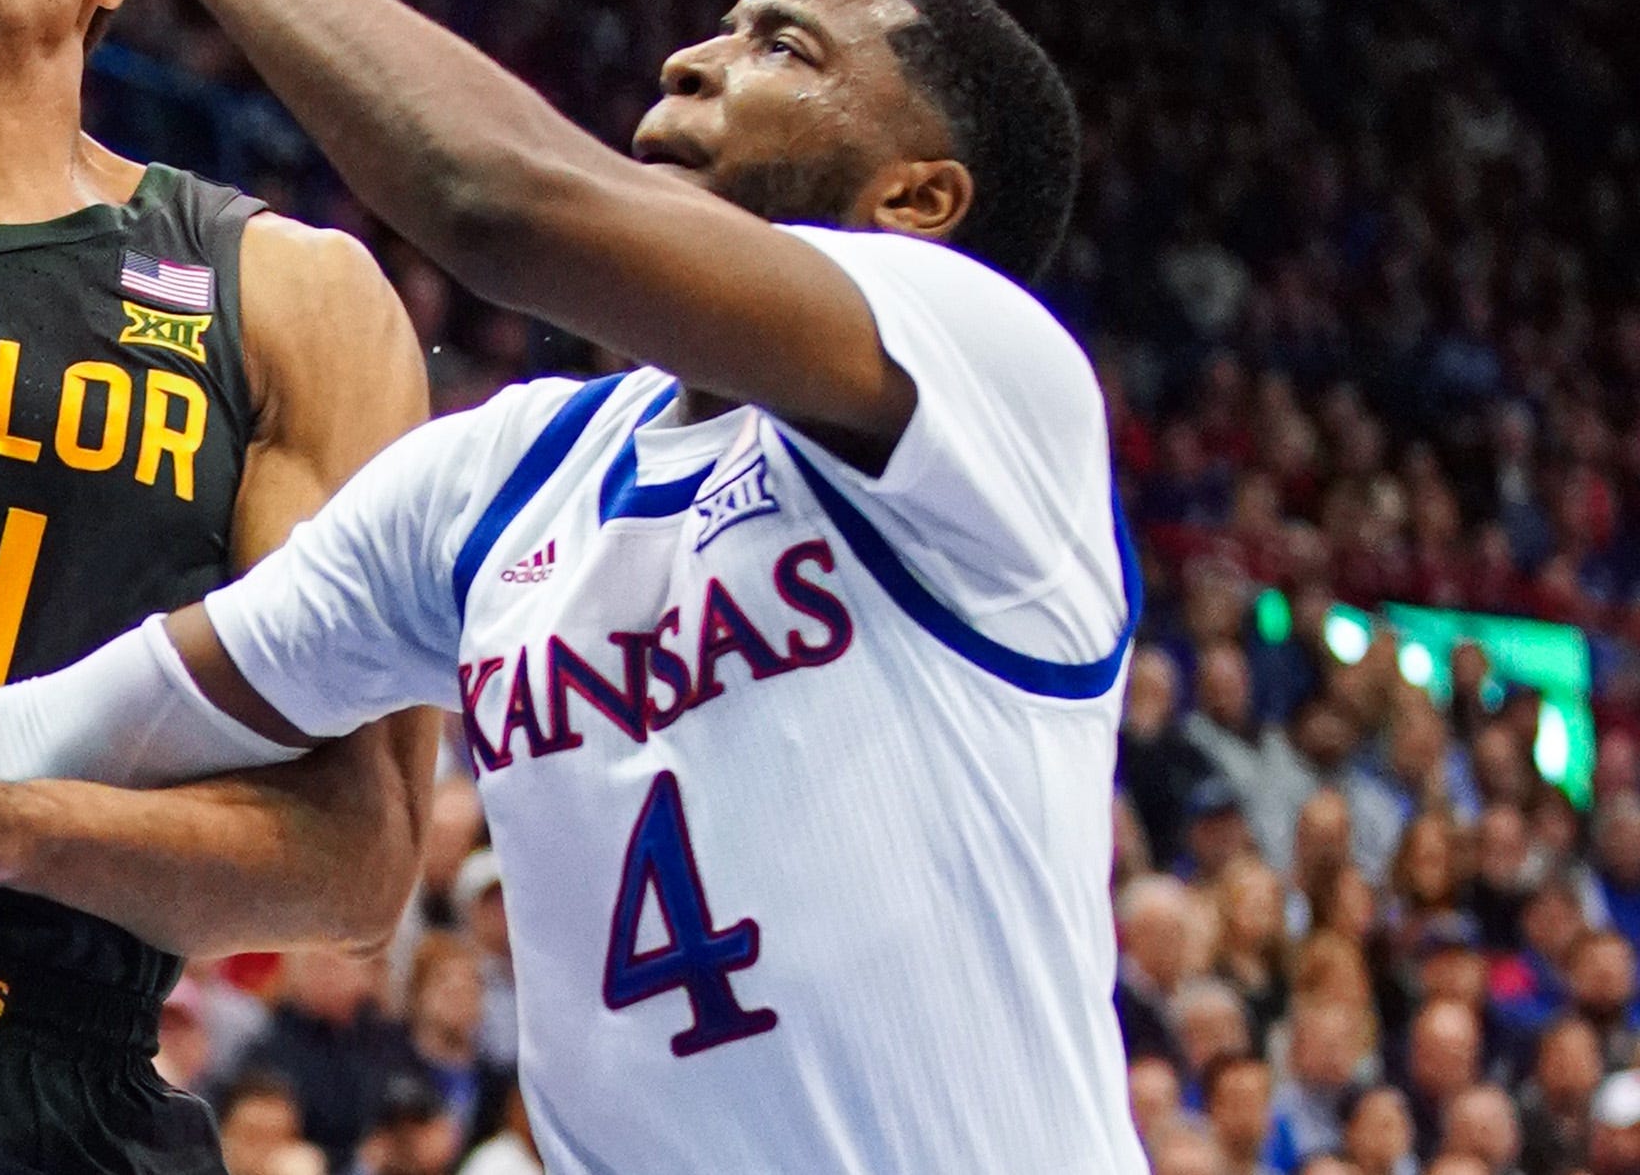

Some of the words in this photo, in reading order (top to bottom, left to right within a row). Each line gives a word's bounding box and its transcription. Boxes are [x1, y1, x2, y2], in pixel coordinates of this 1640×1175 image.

[122, 302, 210, 361] XII
[457, 539, 853, 778] KANSAS
[603, 770, 778, 1057] 4
